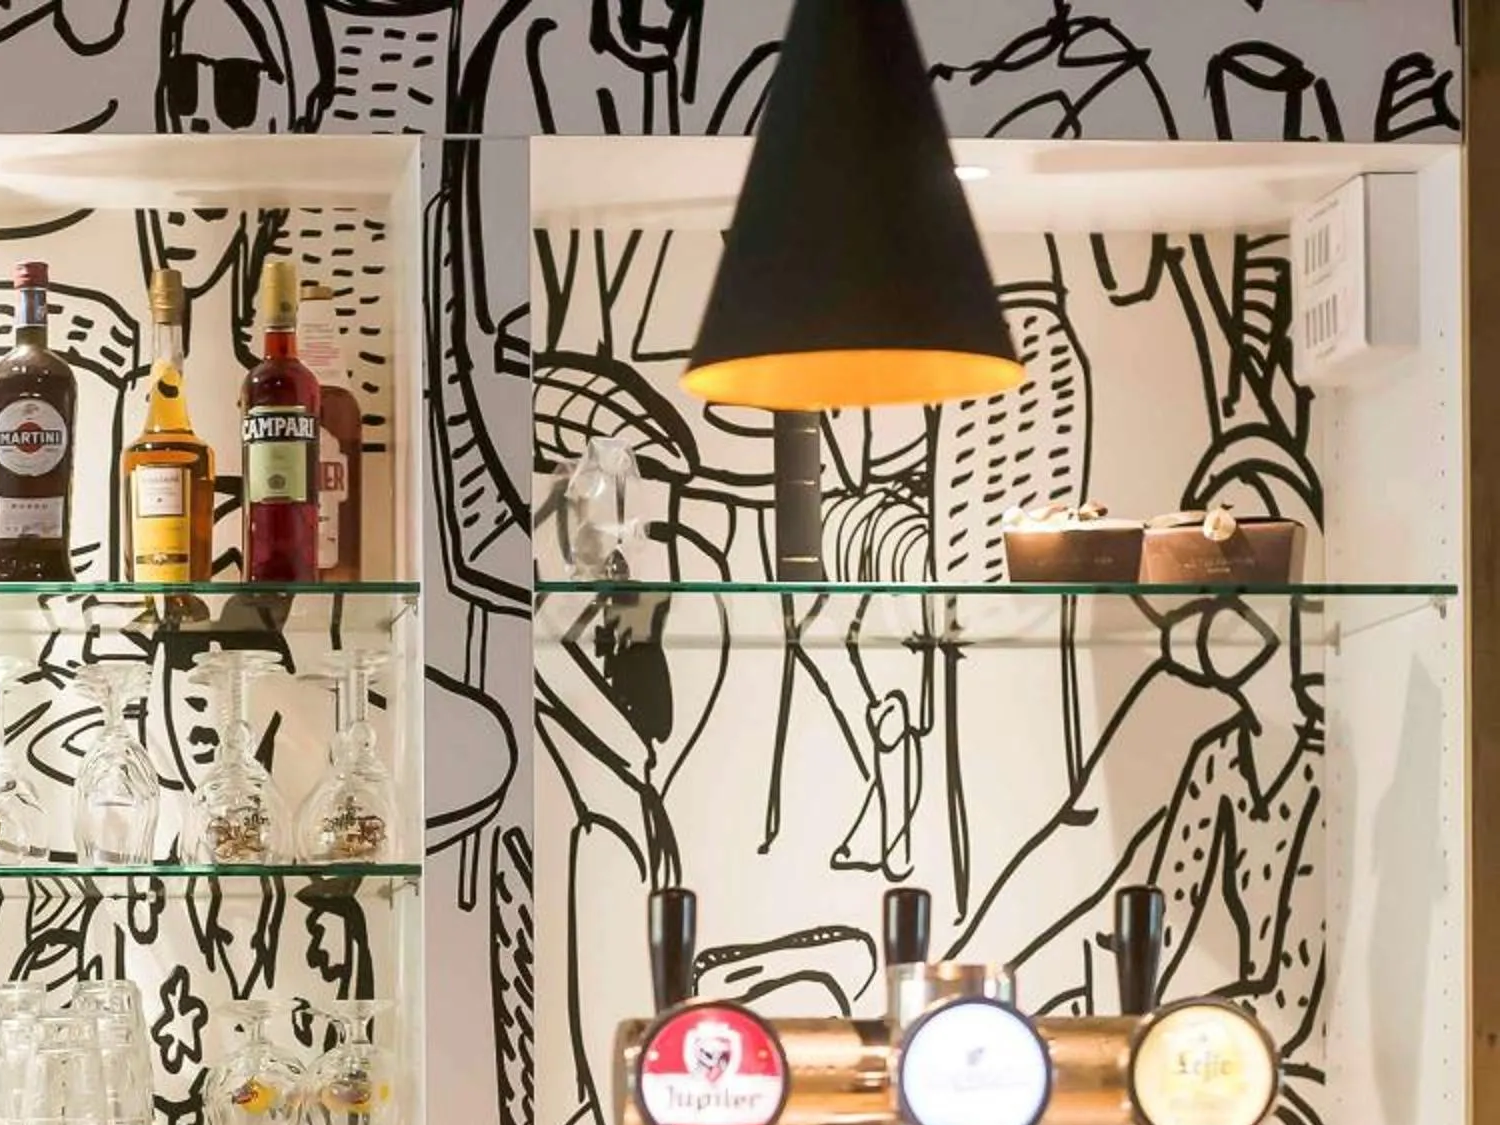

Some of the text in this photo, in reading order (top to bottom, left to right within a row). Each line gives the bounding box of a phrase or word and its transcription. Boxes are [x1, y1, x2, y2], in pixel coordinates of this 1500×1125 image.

[0, 431, 60, 444] MARTINI
[242, 416, 314, 441] CAMPARI
[665, 1085, 762, 1110] Jupiler
